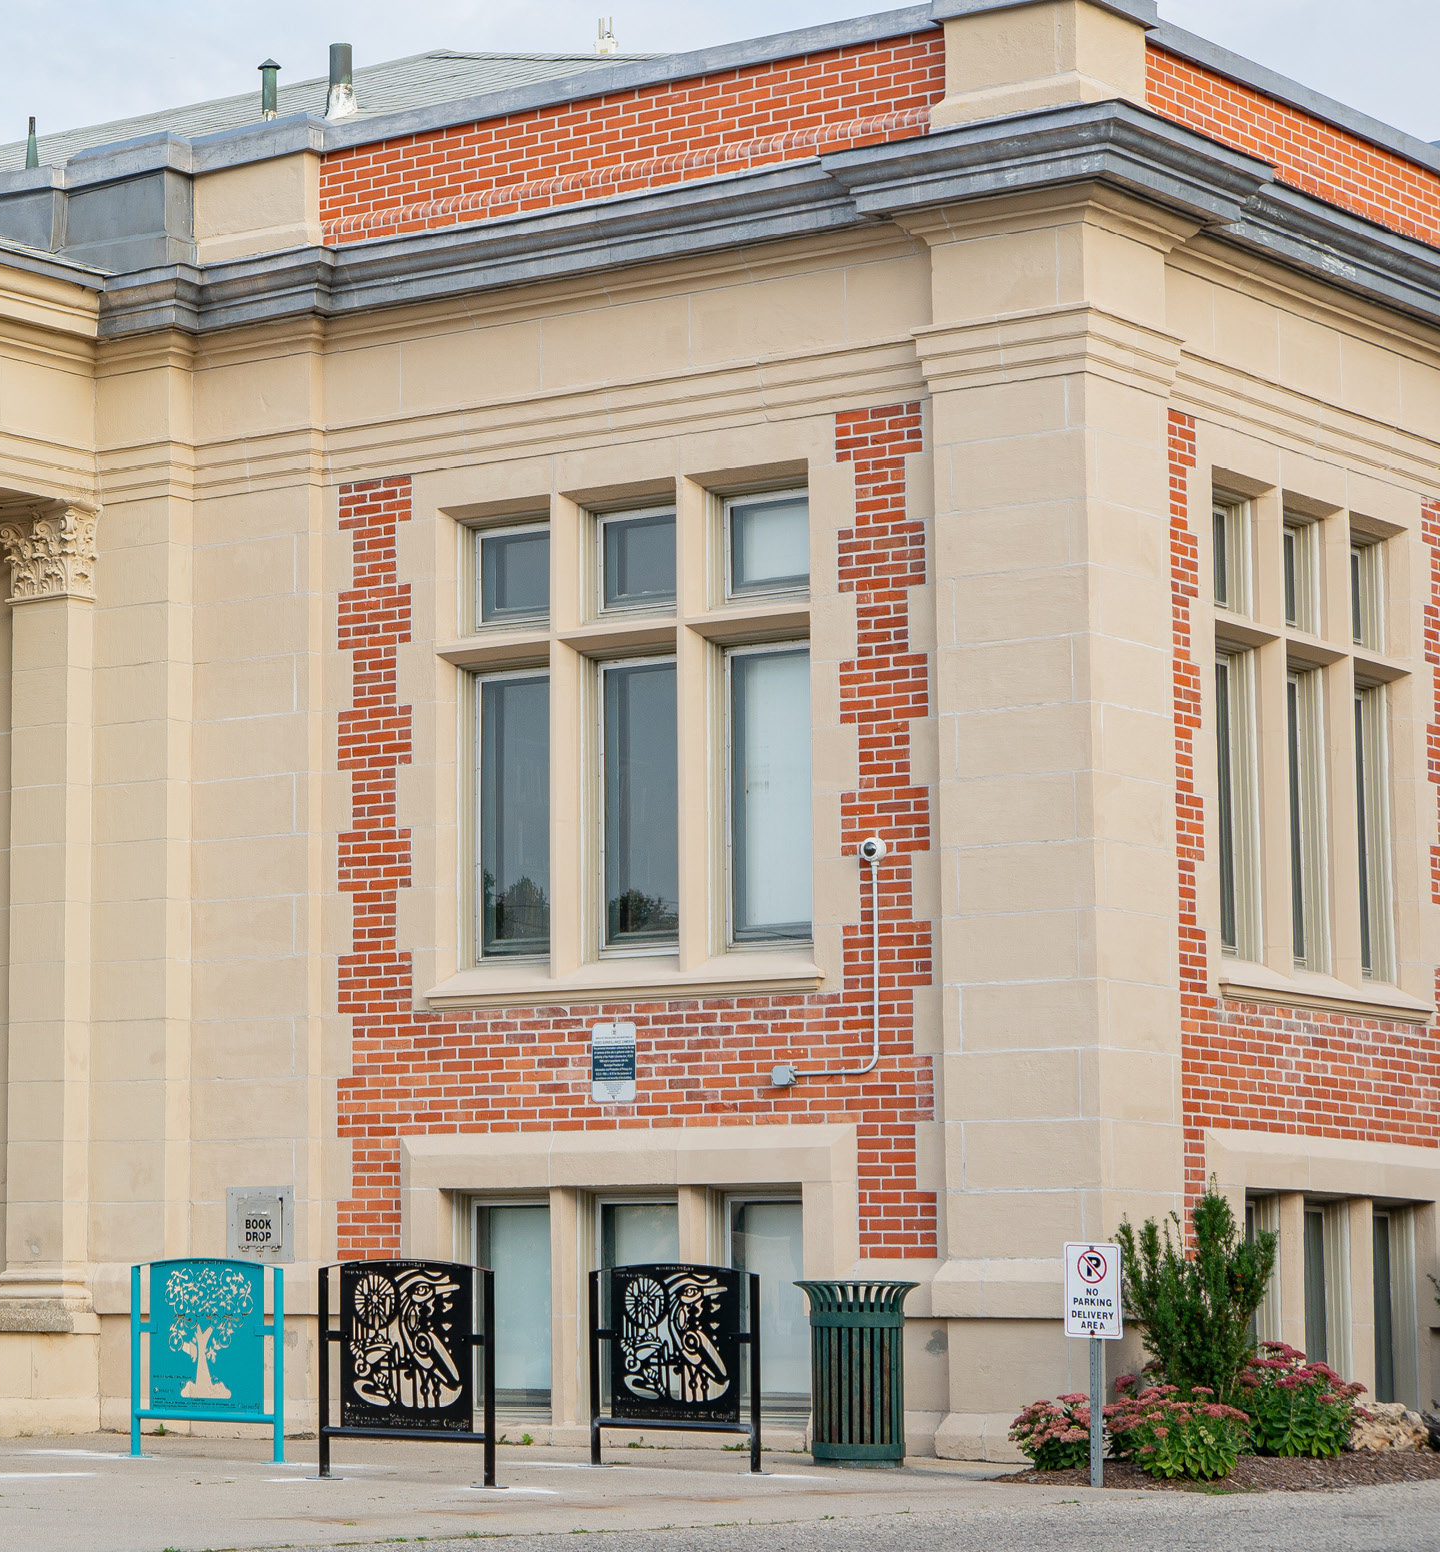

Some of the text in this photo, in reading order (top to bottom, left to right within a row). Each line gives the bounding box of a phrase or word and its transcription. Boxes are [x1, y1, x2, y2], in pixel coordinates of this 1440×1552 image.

[245, 1219, 272, 1230] BOOK
[245, 1231, 272, 1242] DROP
[1086, 1288, 1099, 1296] NO
[1073, 1297, 1112, 1307] PARKING
[1071, 1310, 1114, 1320] DELIVERY
[1080, 1321, 1105, 1330] AREA
